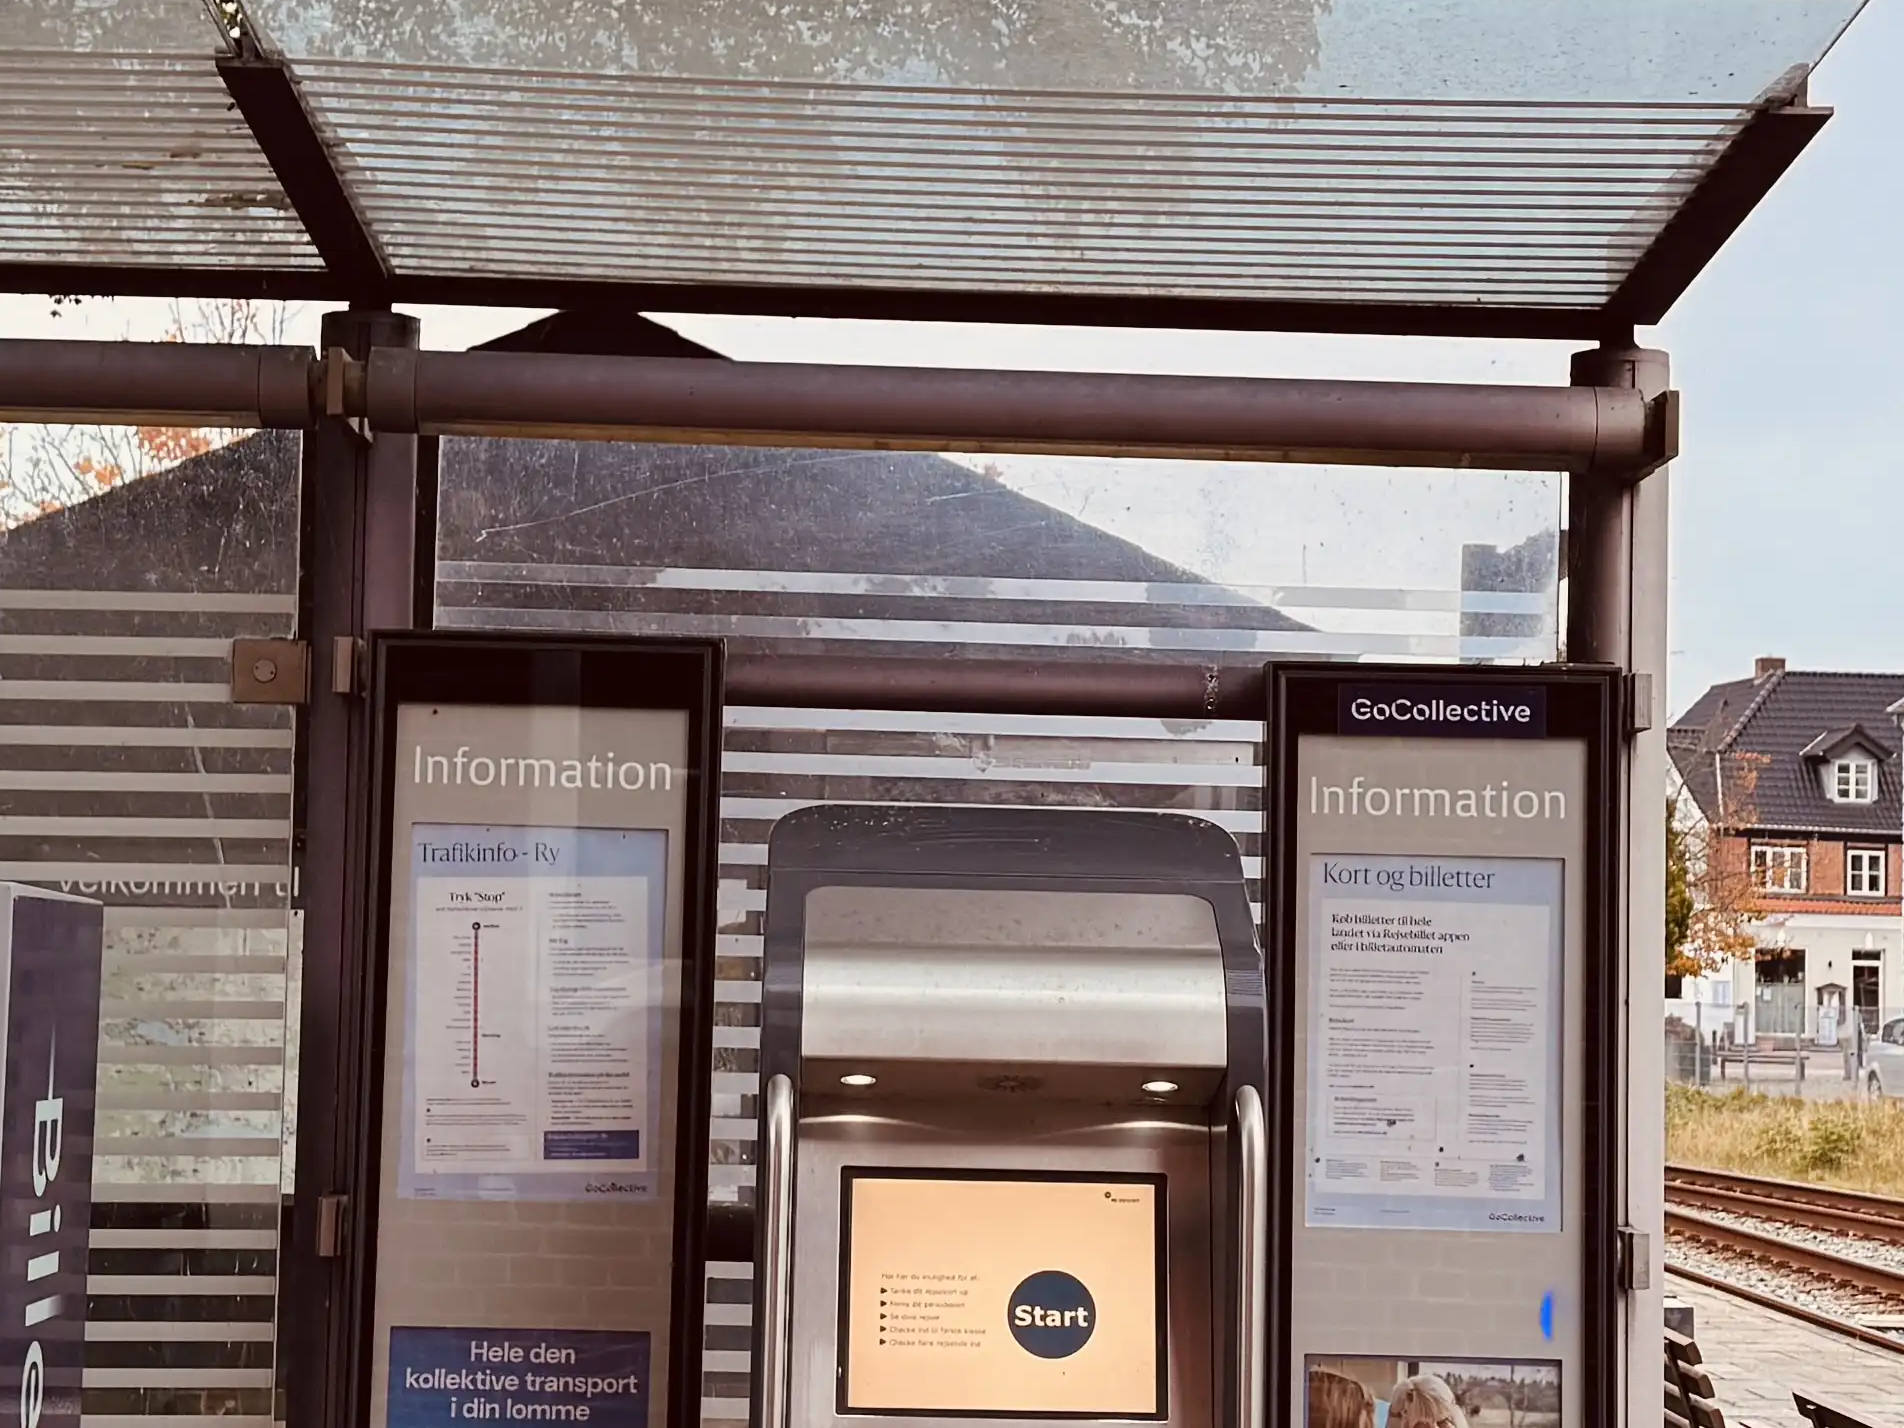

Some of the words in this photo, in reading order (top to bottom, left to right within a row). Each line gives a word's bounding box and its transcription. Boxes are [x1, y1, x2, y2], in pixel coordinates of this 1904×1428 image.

[1352, 699, 1530, 722] GoCollective
[415, 746, 671, 790] Information
[1312, 777, 1565, 818] Information
[418, 843, 517, 862] Trafikinfo
[536, 843, 560, 865] Ry
[1325, 863, 1370, 884] Kort
[1377, 870, 1404, 891] og
[1410, 866, 1495, 888] billetter
[1015, 1305, 1088, 1327] Start
[471, 1341, 523, 1362] Hele
[530, 1343, 575, 1363] den
[406, 1367, 518, 1390] kollektive
[525, 1373, 637, 1397] transport
[451, 1397, 457, 1417] i
[463, 1398, 499, 1418] din
[507, 1398, 589, 1420] lomme
